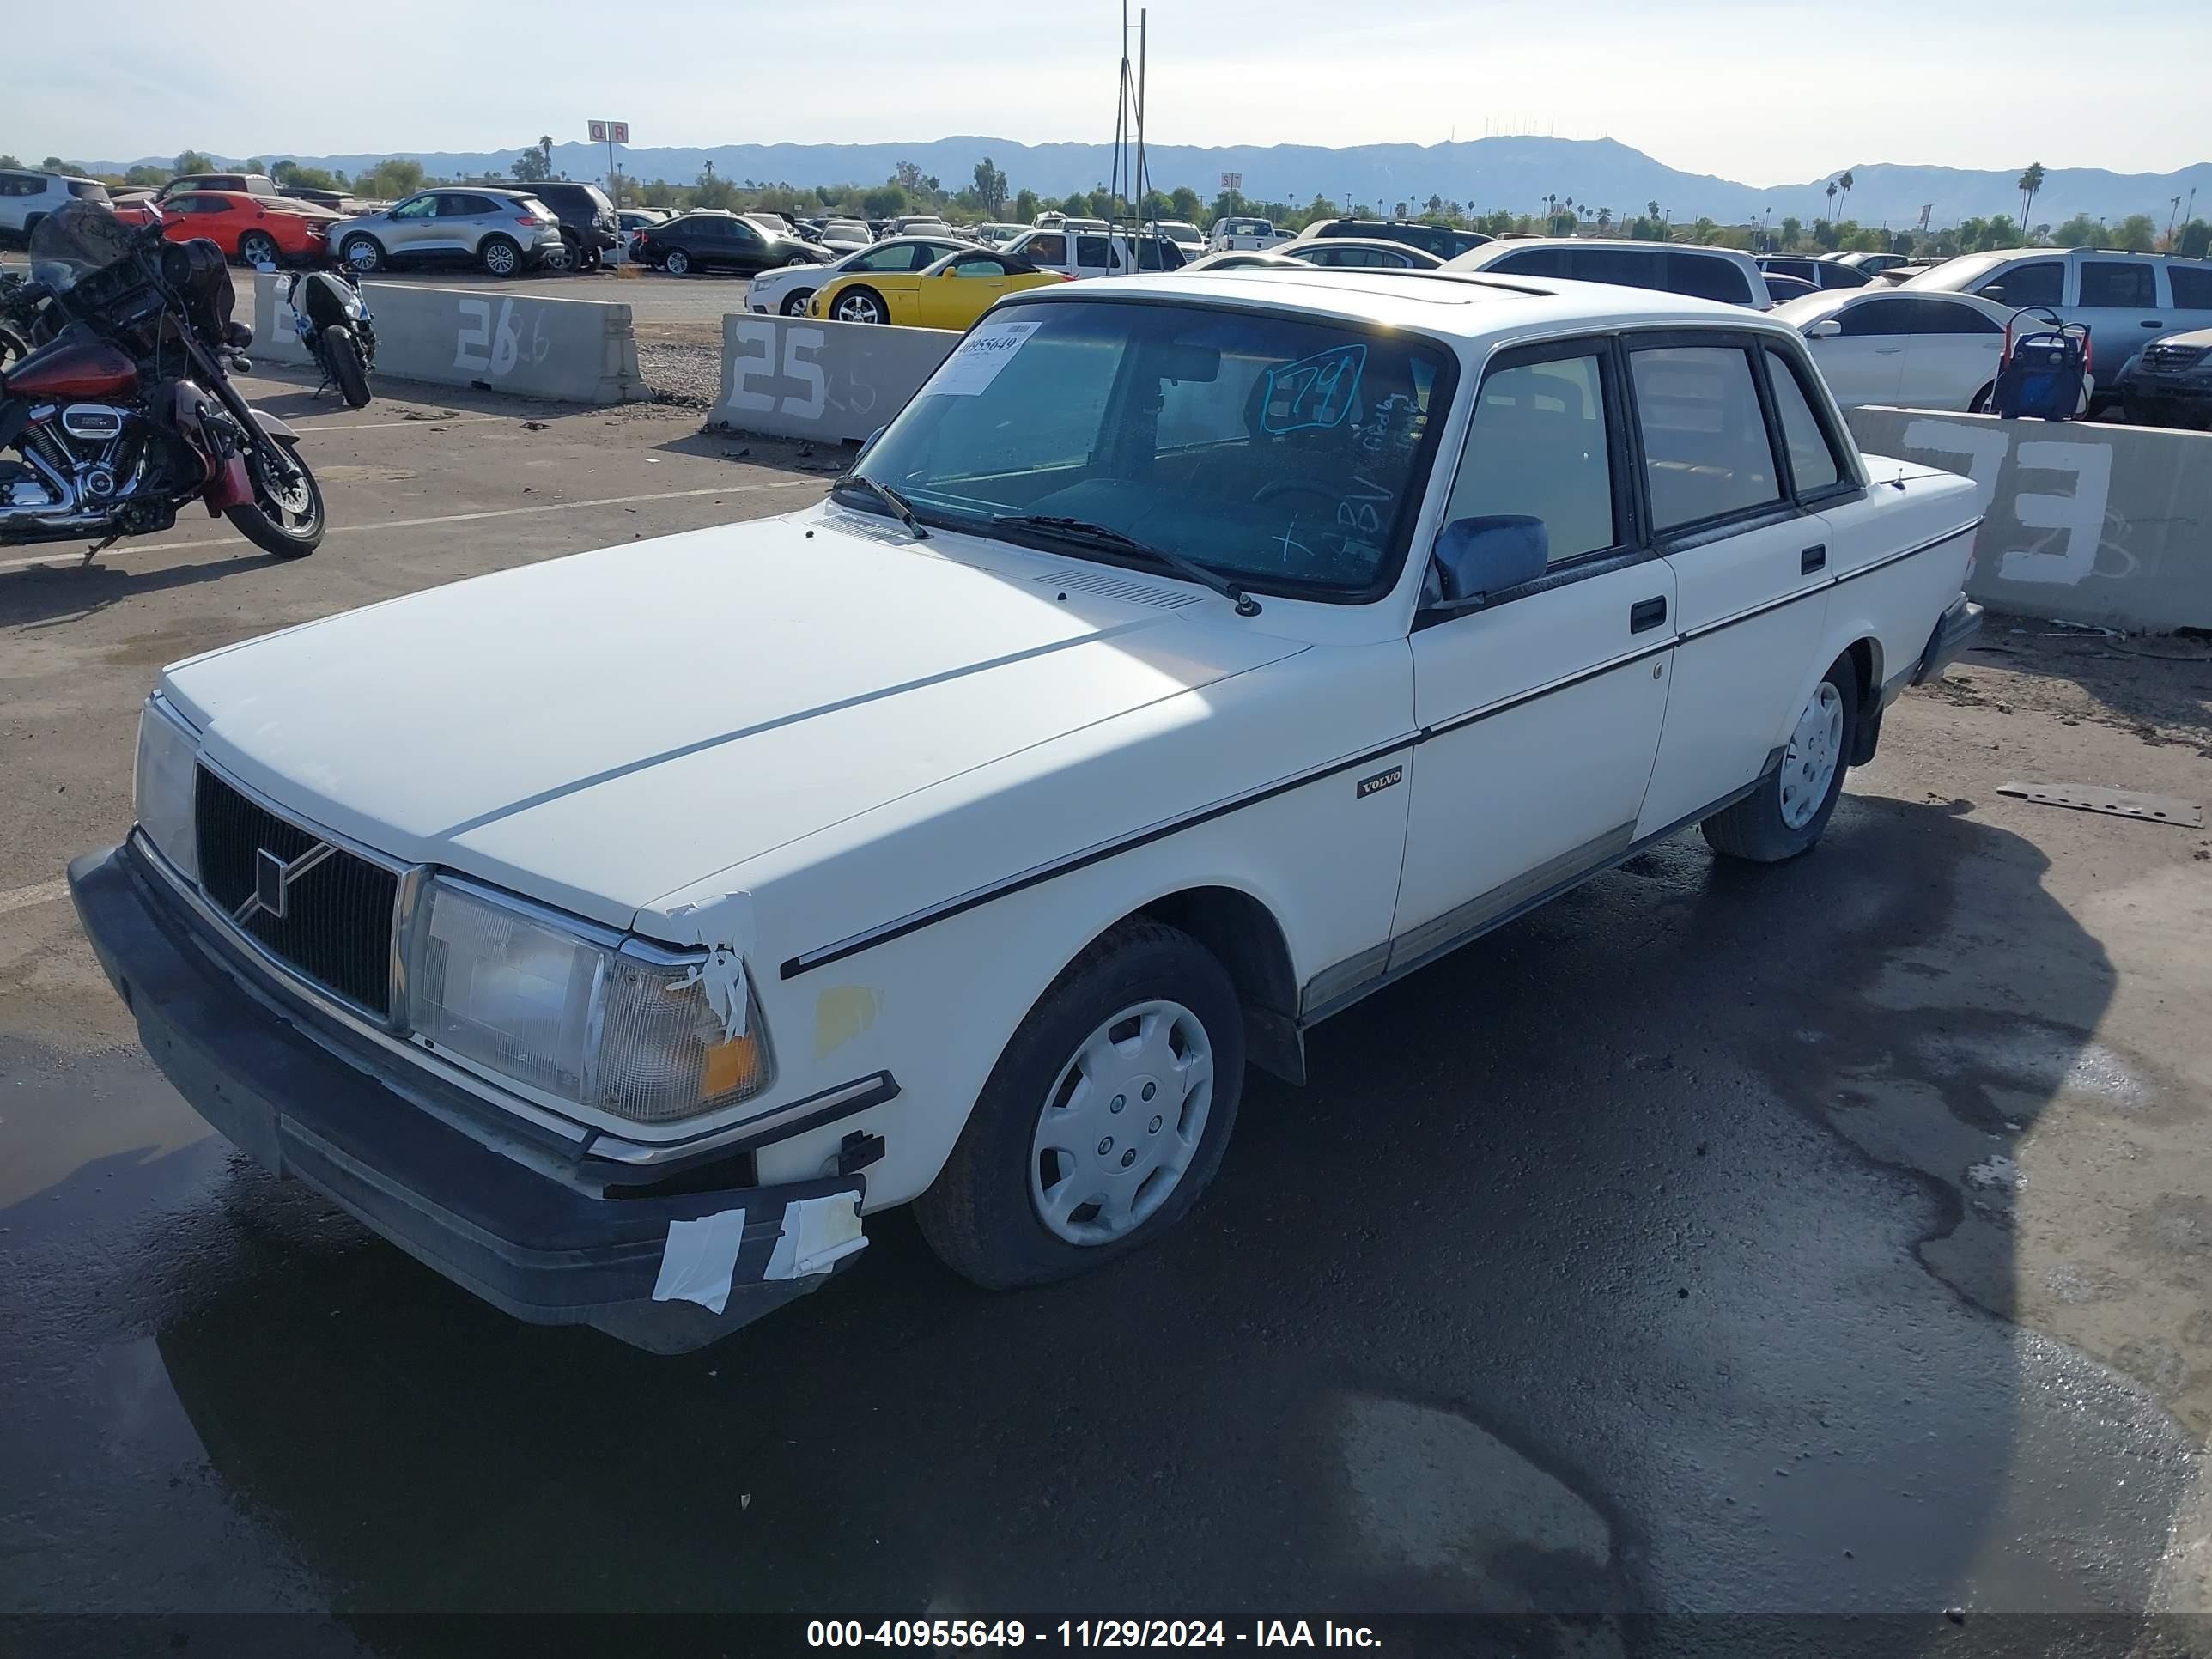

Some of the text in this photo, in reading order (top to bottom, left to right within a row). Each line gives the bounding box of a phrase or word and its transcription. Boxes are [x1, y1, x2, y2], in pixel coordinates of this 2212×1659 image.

[592, 124, 625, 141] Q R
[1223, 175, 1240, 186] S T
[453, 297, 517, 375] 26
[727, 320, 825, 420] 25
[1363, 771, 1401, 793] VOLVO
